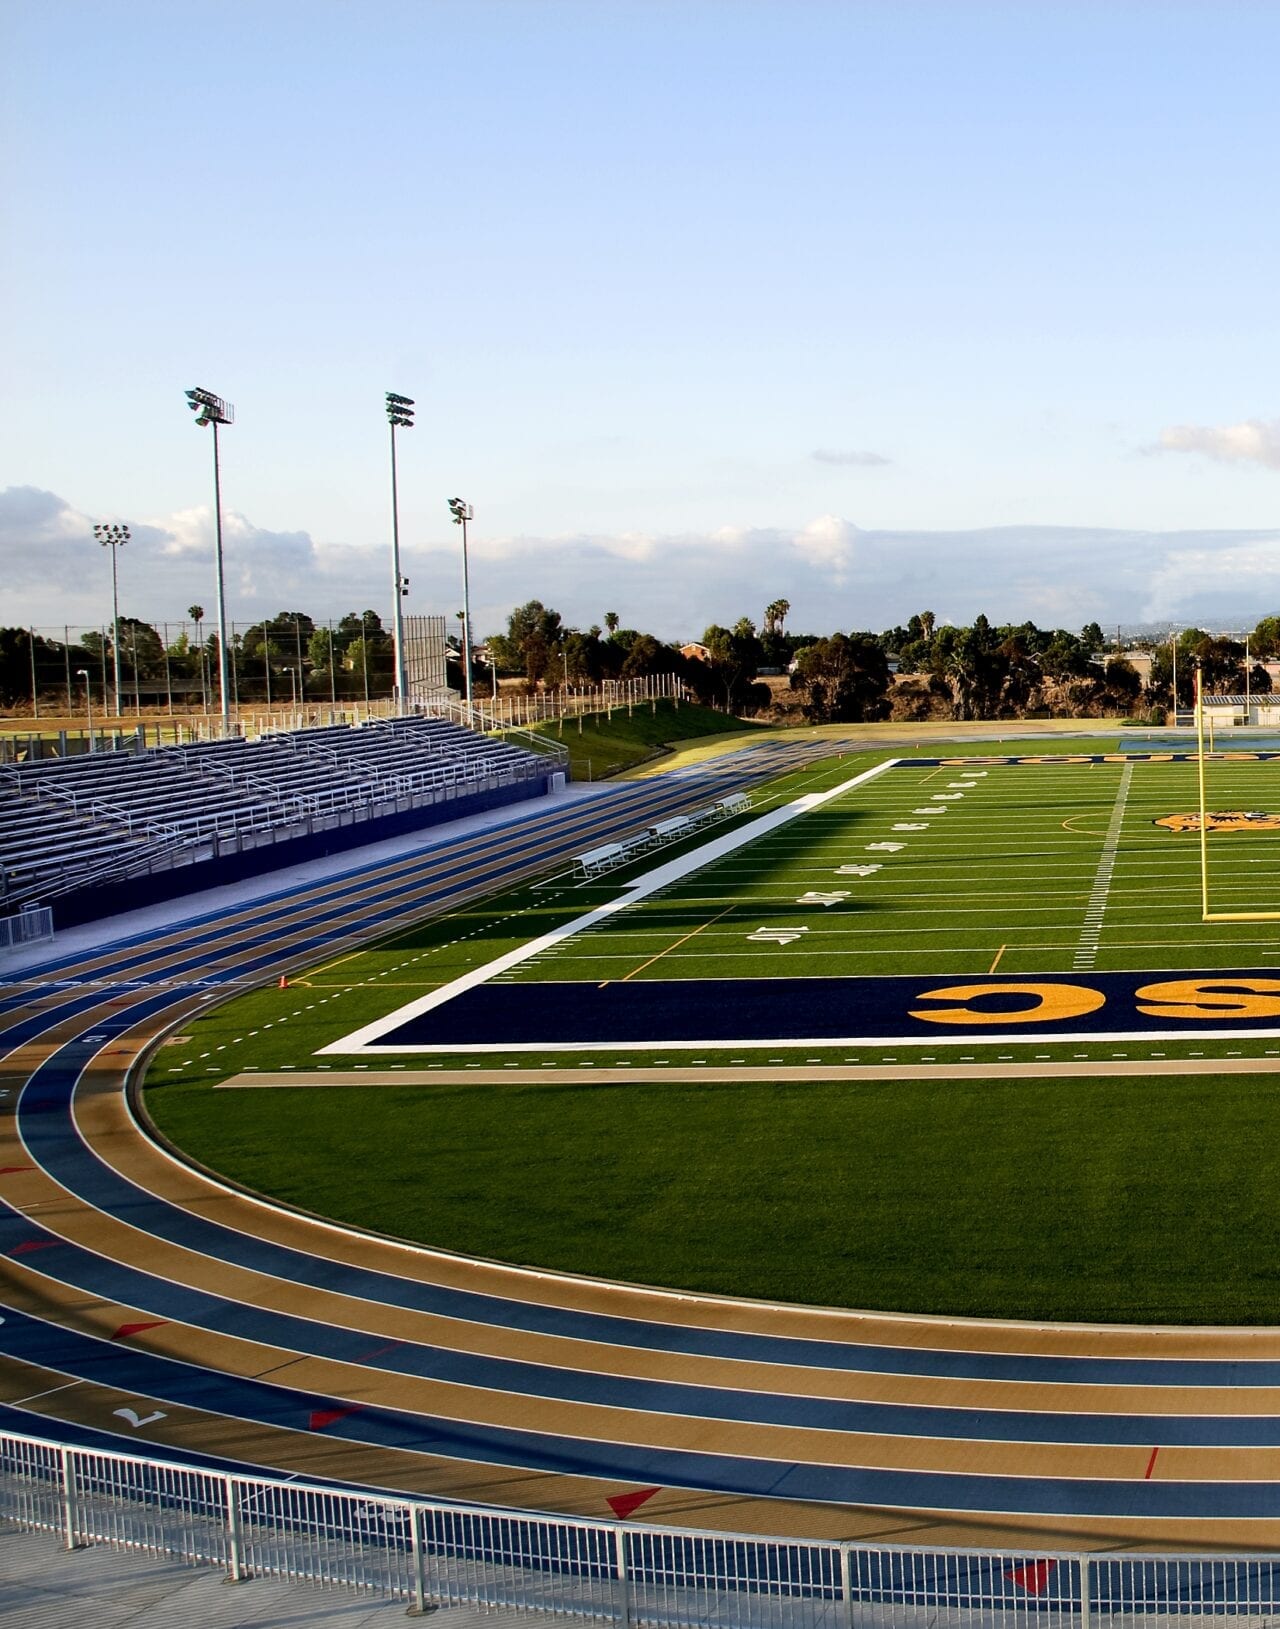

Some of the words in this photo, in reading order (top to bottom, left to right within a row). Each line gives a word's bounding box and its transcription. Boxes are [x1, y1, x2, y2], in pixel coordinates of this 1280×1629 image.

[796, 890, 852, 904] 20
[745, 926, 810, 941] 10
[112, 1408, 168, 1428] 7
